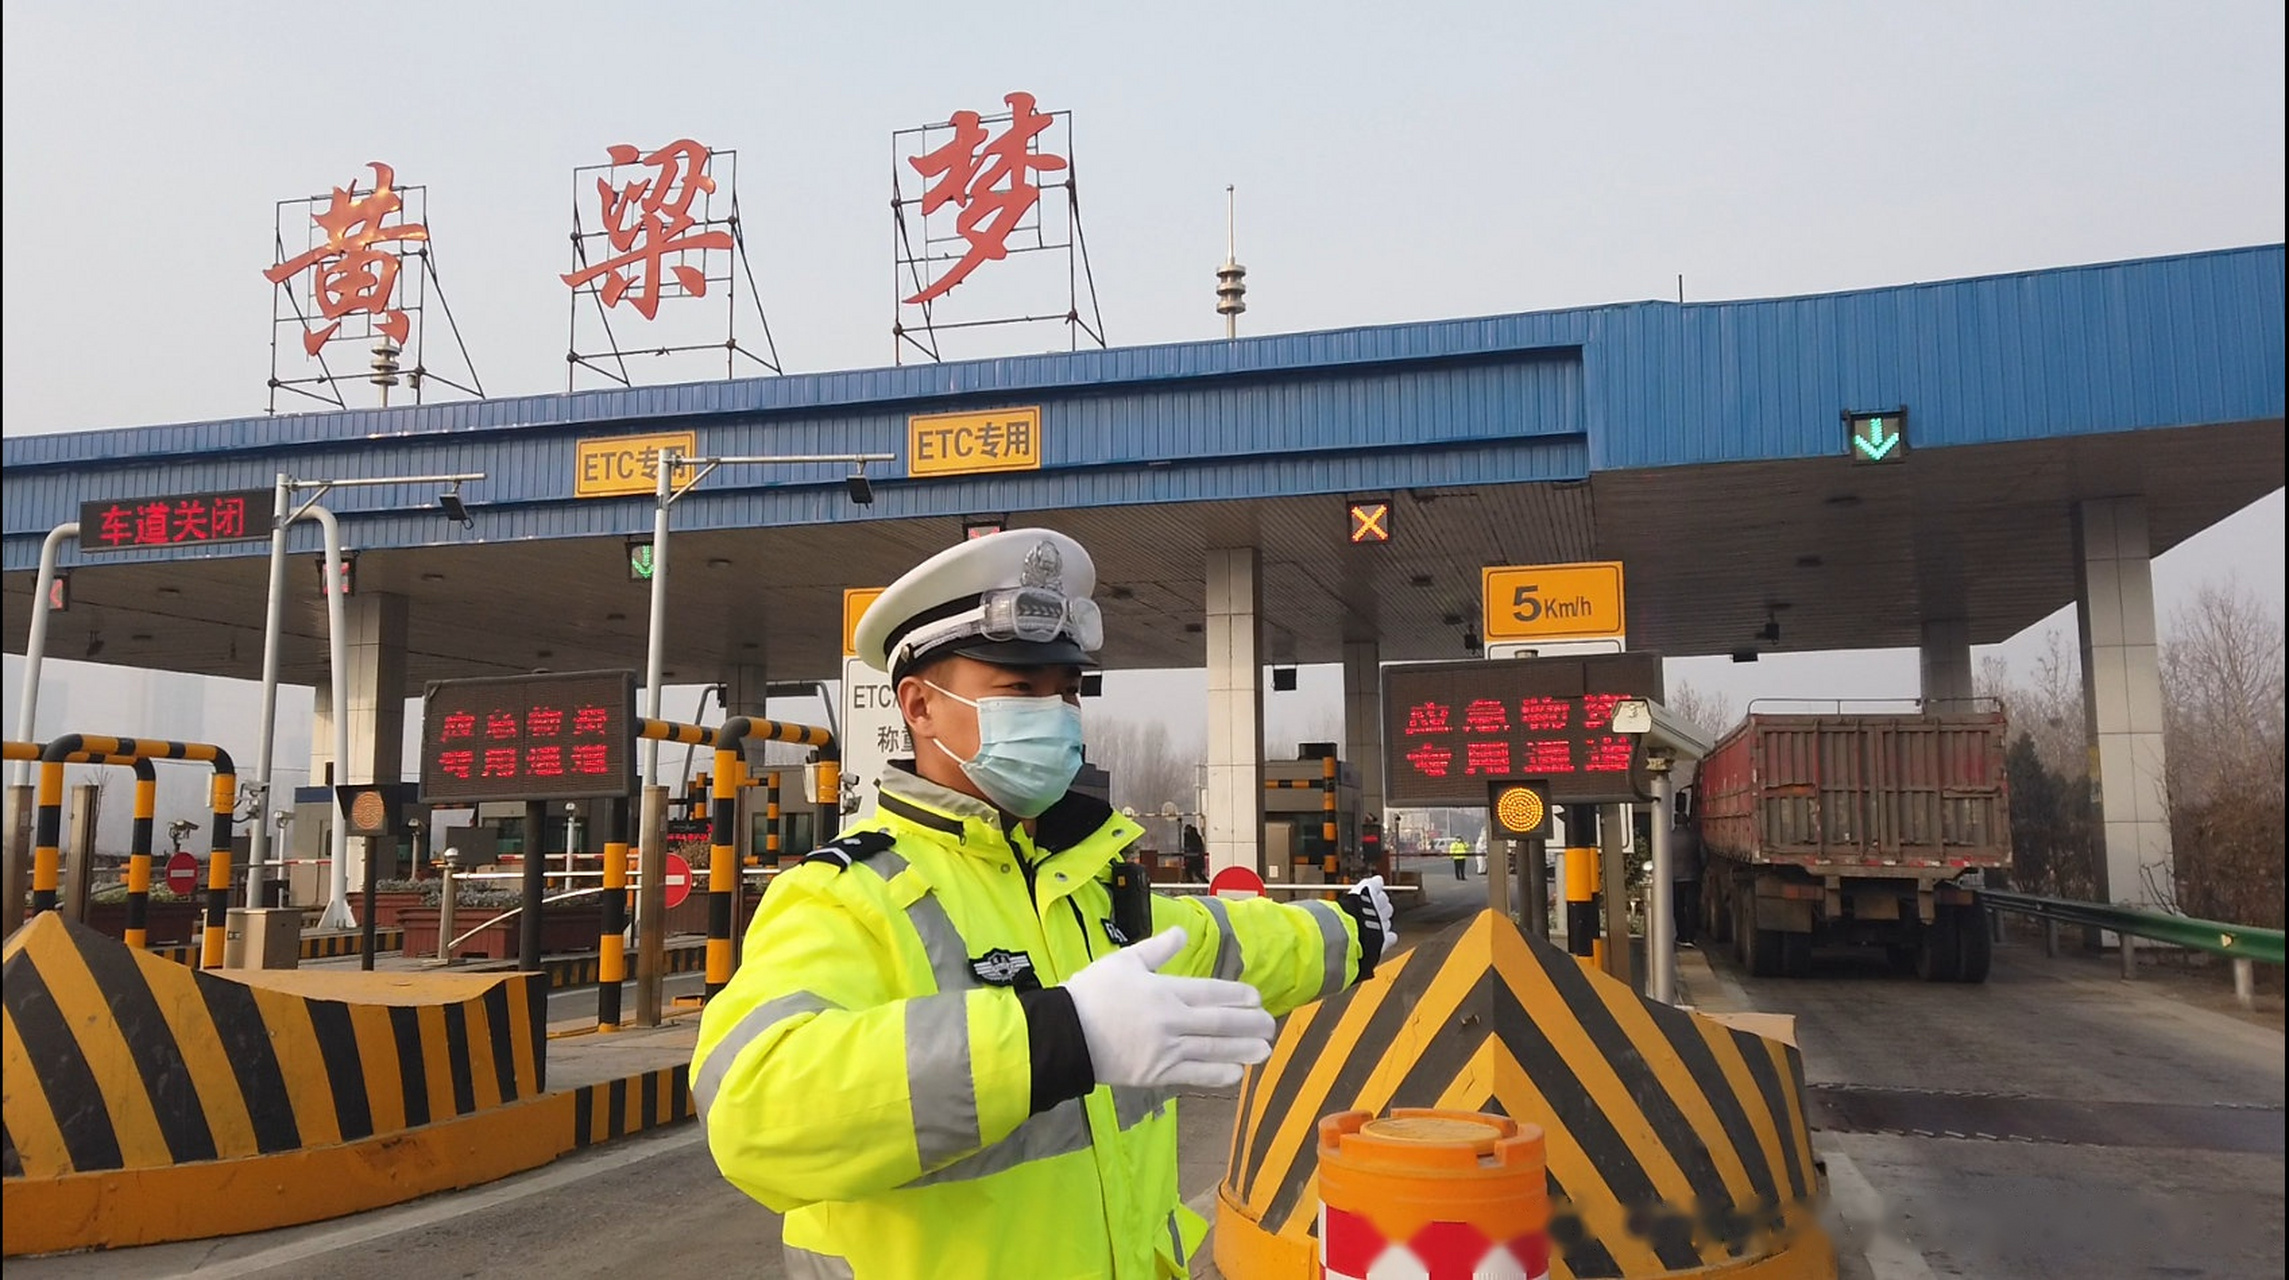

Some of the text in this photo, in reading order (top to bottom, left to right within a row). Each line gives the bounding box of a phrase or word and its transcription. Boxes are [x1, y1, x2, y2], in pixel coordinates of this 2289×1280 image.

[917, 420, 1030, 460] ETC专用
[100, 497, 245, 547] 车道关闭
